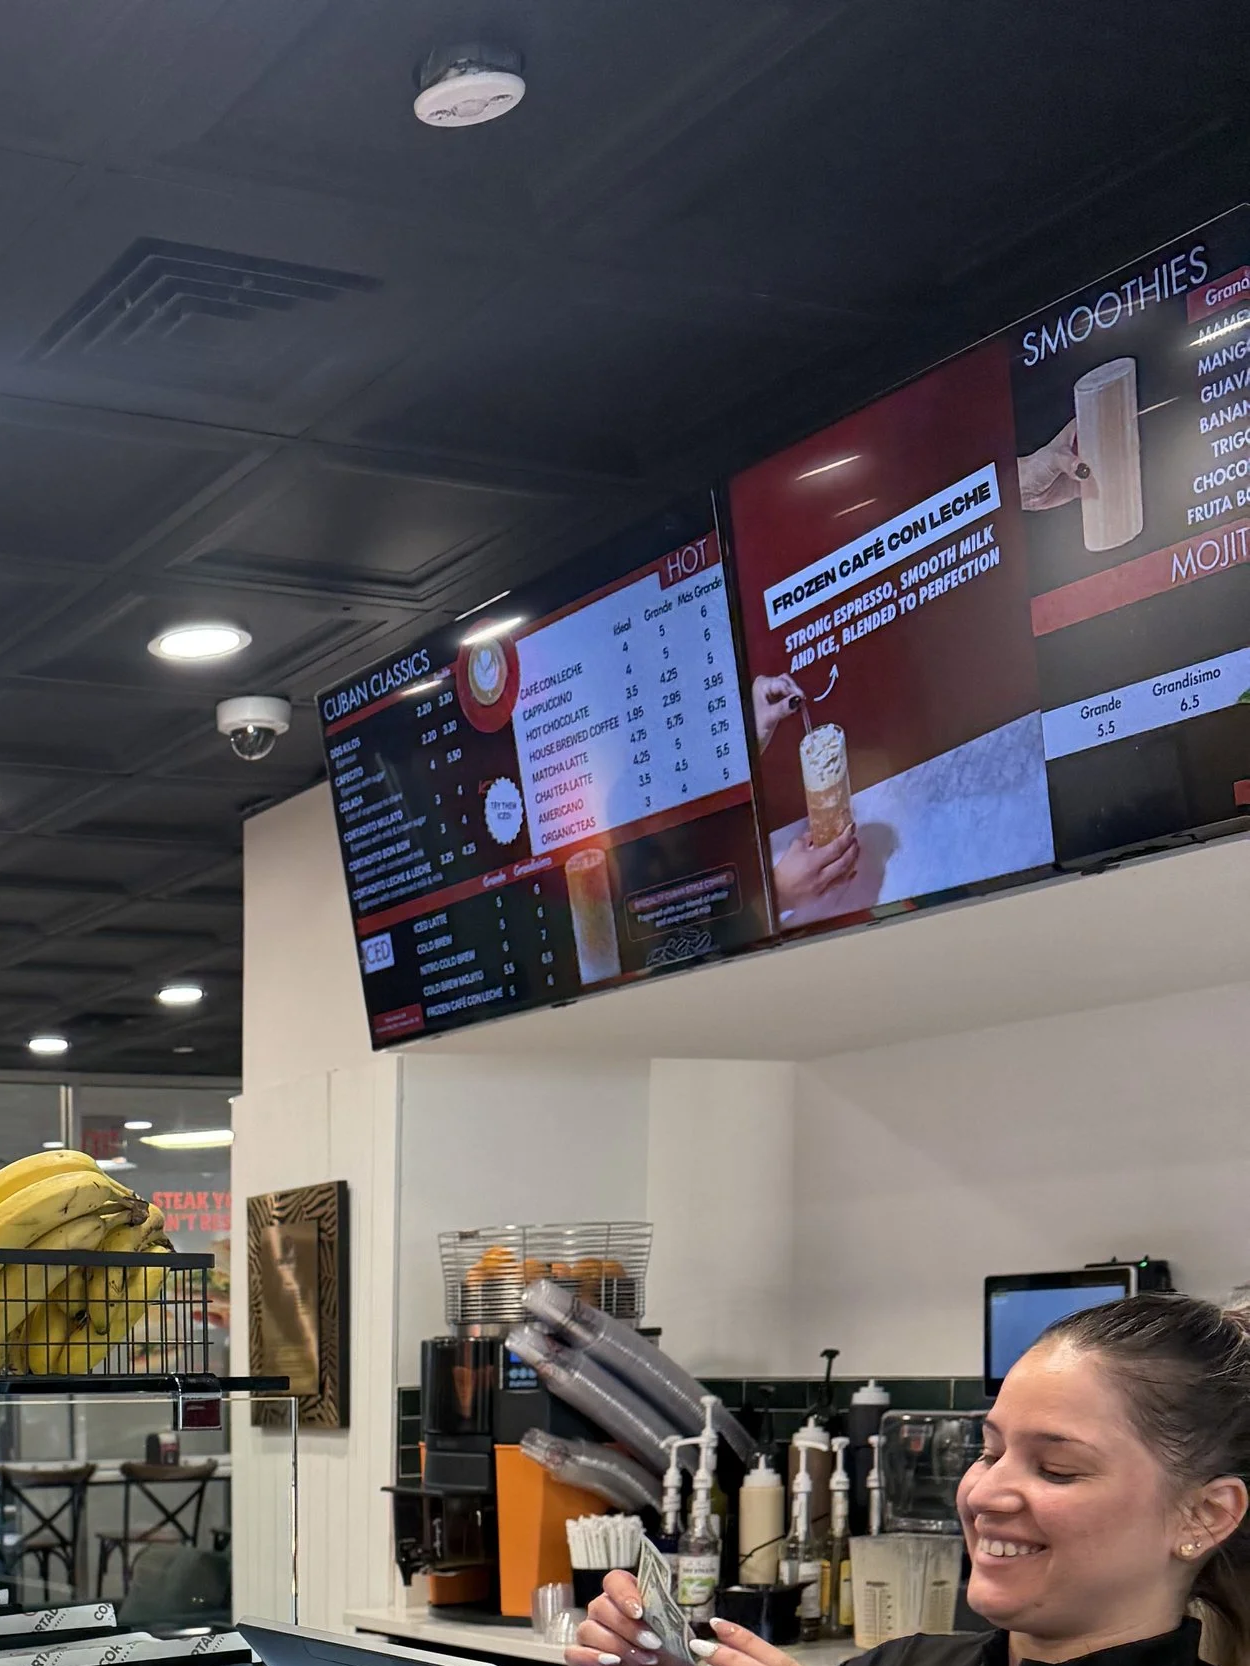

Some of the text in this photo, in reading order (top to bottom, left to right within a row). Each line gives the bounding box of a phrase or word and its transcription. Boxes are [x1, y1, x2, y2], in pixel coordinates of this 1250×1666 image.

[1023, 246, 1209, 366] SMOOTHIES
[1187, 495, 1233, 525] FRUTA
[1193, 459, 1250, 493] CHOCO
[667, 539, 706, 582] HOT
[772, 481, 991, 616] FROZEN CAFÉ CON LECHE
[644, 600, 672, 621] Grande
[694, 576, 722, 597] Grande
[785, 524, 995, 653] STRONG ESPRESSO, SMOOTH MILK
[790, 547, 1000, 674] AND ICE, BLENDED TO PERFECTION
[324, 682, 368, 721] CUBAN
[370, 649, 430, 696] CLASSICS
[520, 606, 707, 700] CAFÉ CON LECHE 4 5 6
[523, 628, 711, 721] CAPPUCCINO 4 5 6
[526, 725, 542, 742] HOT
[542, 706, 590, 735] CHOCOLATE
[707, 652, 713, 664] 5
[530, 743, 556, 762] HOUSE
[557, 729, 588, 751] BREWED
[590, 716, 619, 736] COFFEE
[627, 706, 644, 723] 1.95
[704, 672, 723, 691] 3.95
[1080, 667, 1221, 721] Grande Grandísimo
[1097, 695, 1200, 737] 5.5 6.5
[533, 762, 564, 784] MATCHA
[564, 752, 589, 770] LATTE
[667, 713, 683, 729] 5.75
[535, 788, 554, 804] CHAI
[554, 782, 568, 795] TEA
[568, 773, 593, 789] LATTE
[675, 738, 681, 750] 5
[711, 719, 729, 736] 5.75
[539, 799, 584, 824] AMERICANO
[542, 824, 575, 845] ORGANIC
[576, 817, 596, 833] TEAS
[682, 784, 687, 793] 4
[723, 768, 729, 780] 5
[152, 1192, 209, 1210] STEAK
